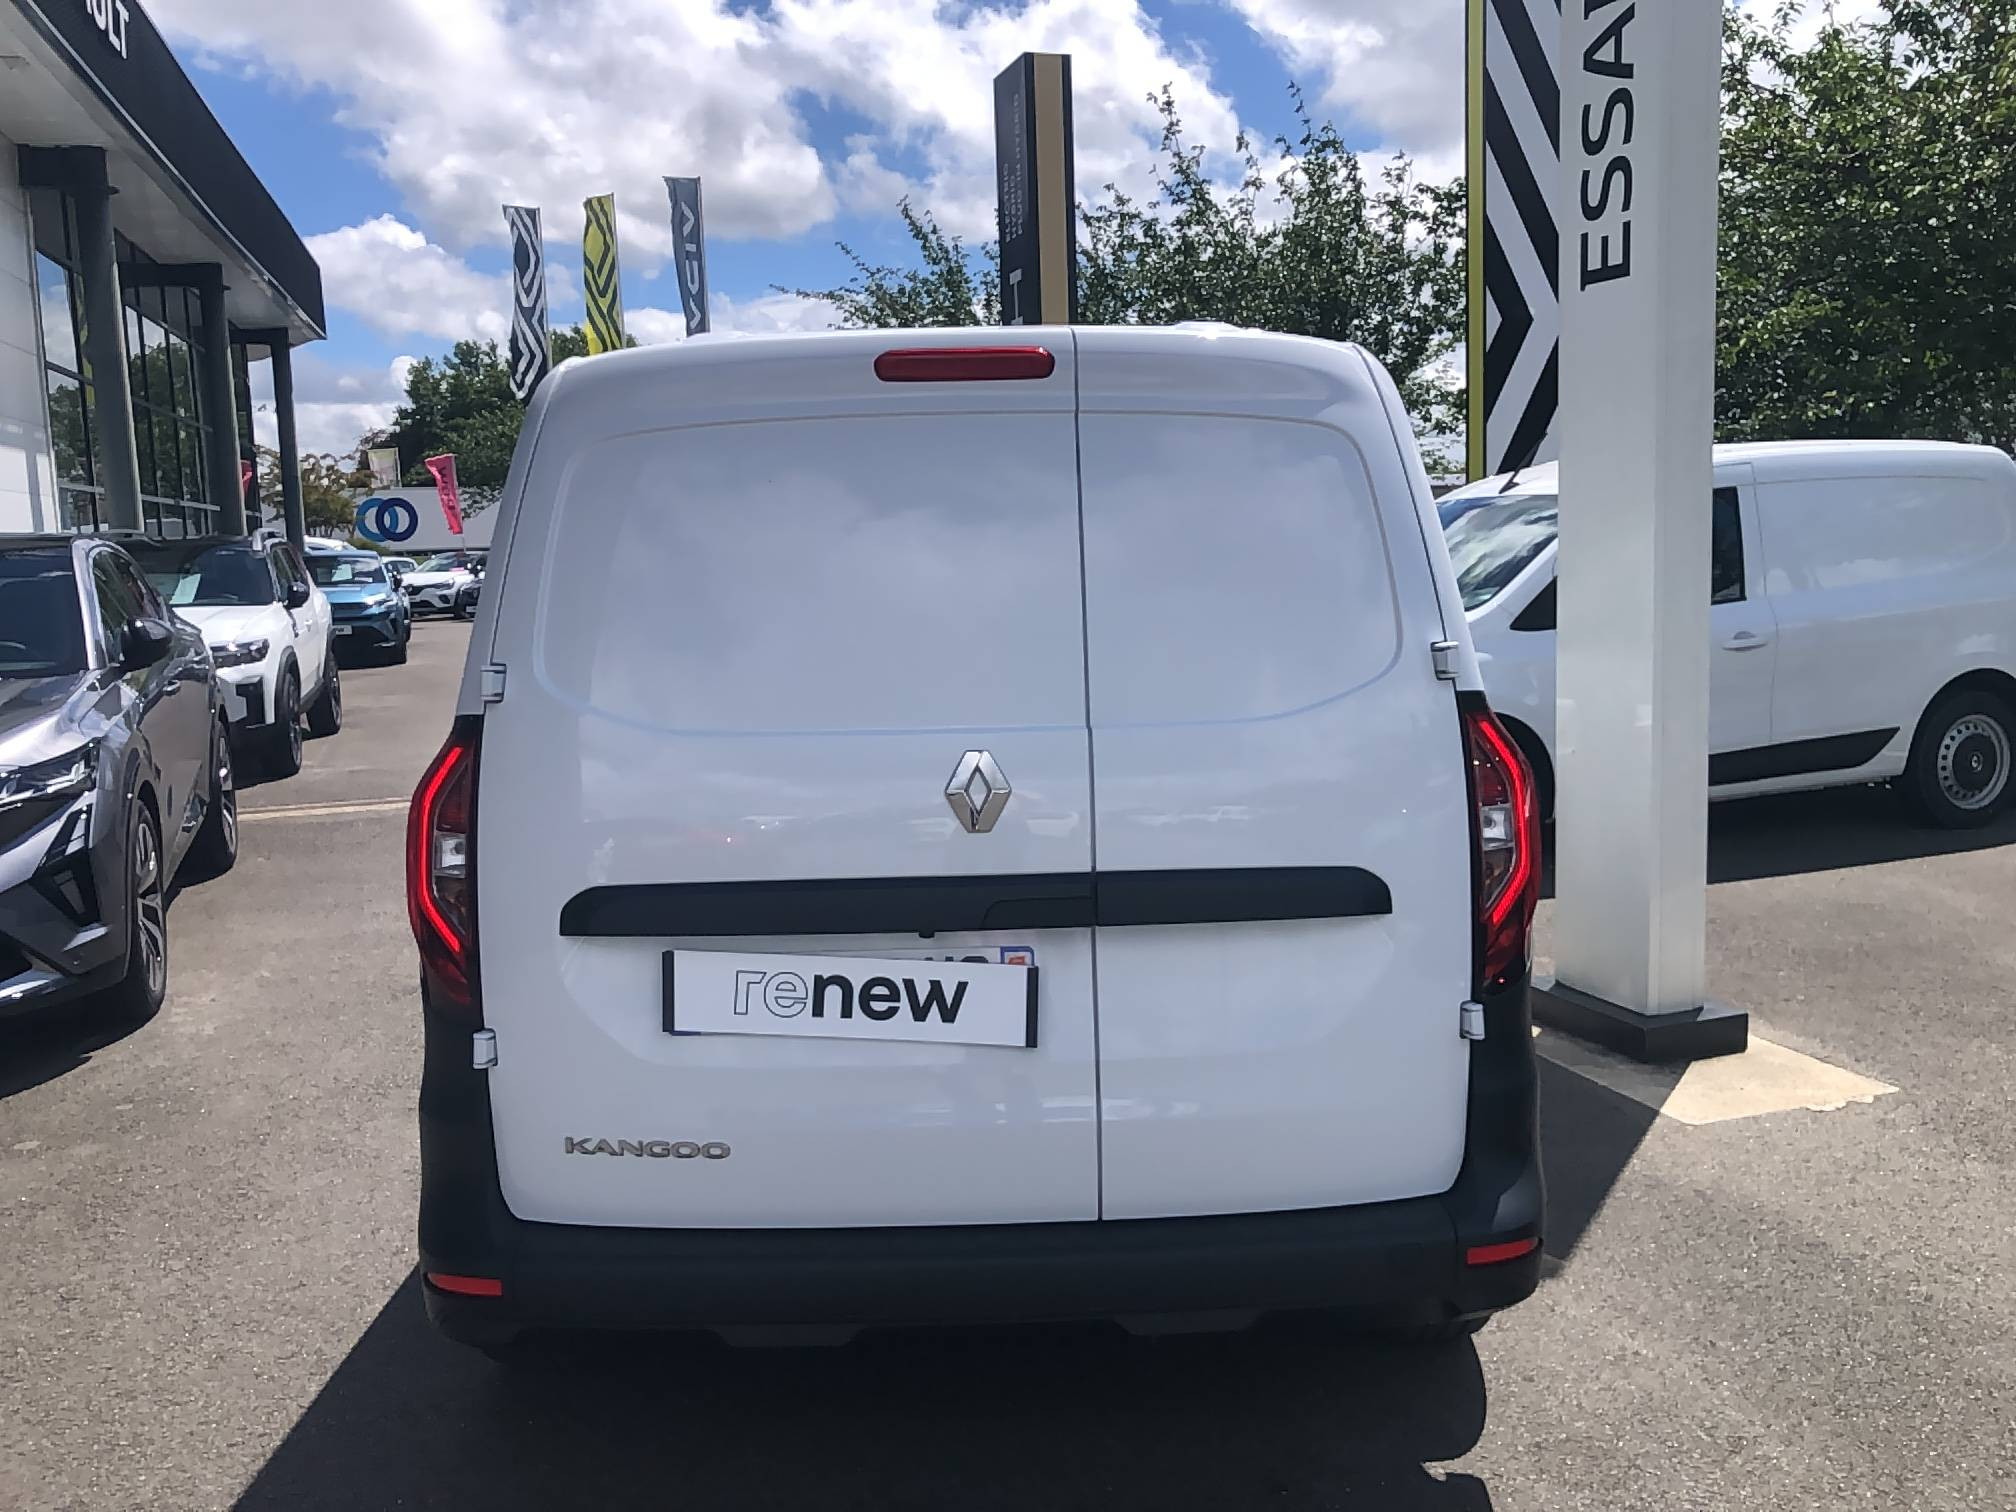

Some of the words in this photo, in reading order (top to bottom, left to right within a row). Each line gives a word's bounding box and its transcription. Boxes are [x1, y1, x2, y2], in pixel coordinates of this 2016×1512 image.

[86, 0, 129, 59] ULT
[1580, 0, 1635, 291] ESSA
[733, 969, 969, 1024] renew
[564, 1136, 731, 1159] KANGOO
